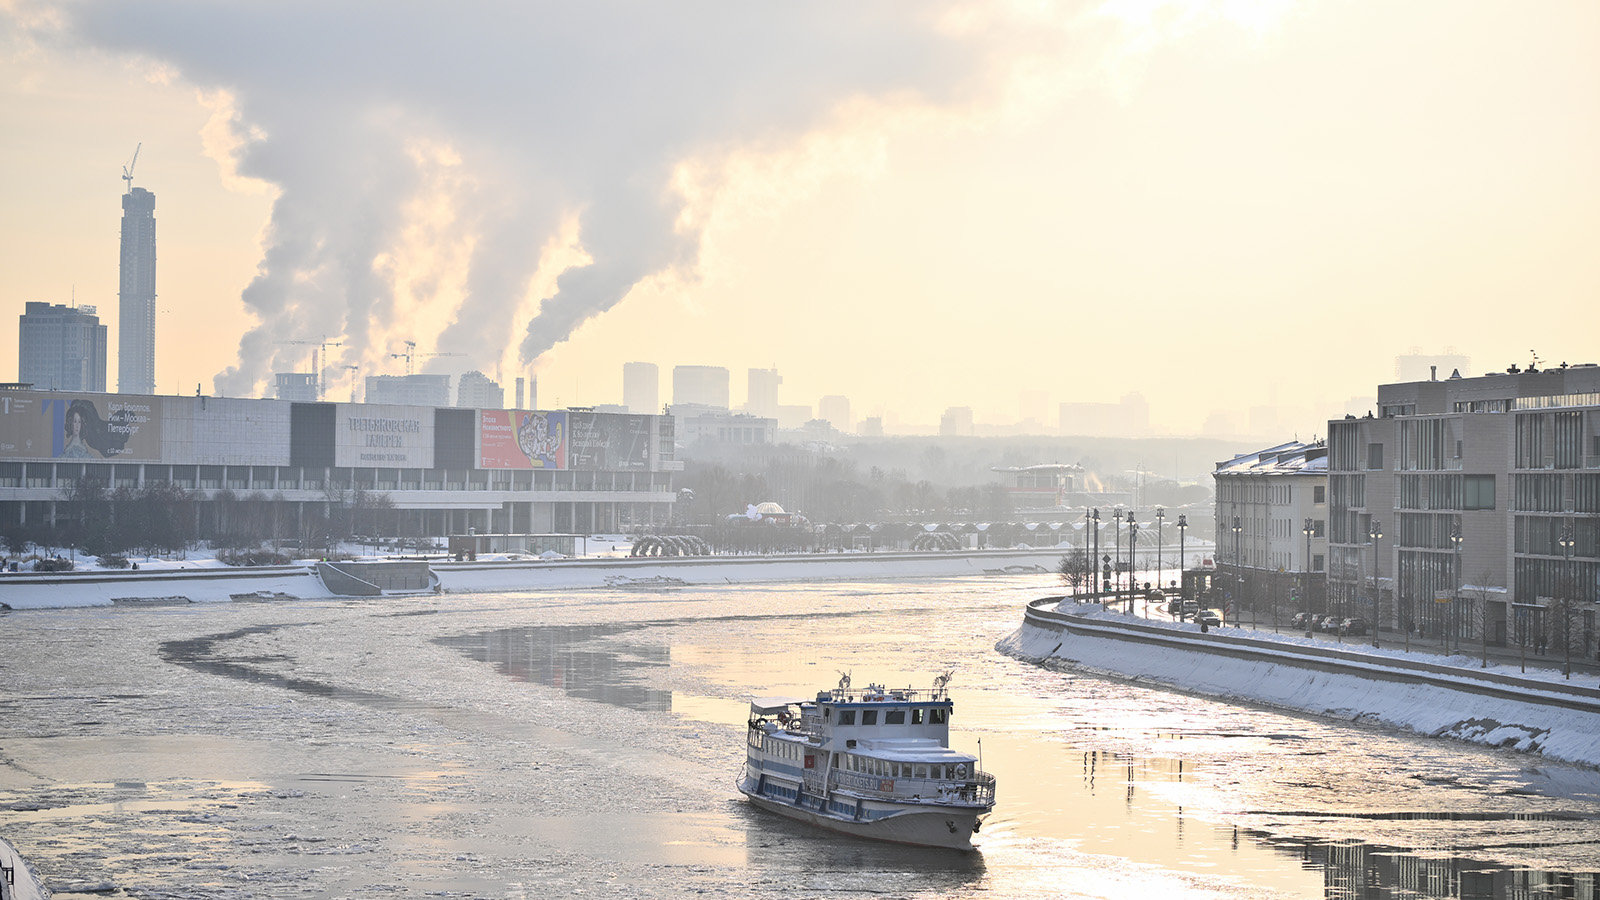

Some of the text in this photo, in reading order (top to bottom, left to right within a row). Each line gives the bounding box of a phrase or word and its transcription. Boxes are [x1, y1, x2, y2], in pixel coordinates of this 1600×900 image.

[108, 402, 123, 411] Карл
[108, 423, 139, 435] Петербург
[349, 417, 420, 433] ТРЕТЬЯКОВСКАЯ
[365, 433, 402, 448] ГАЛЕРЕЯ
